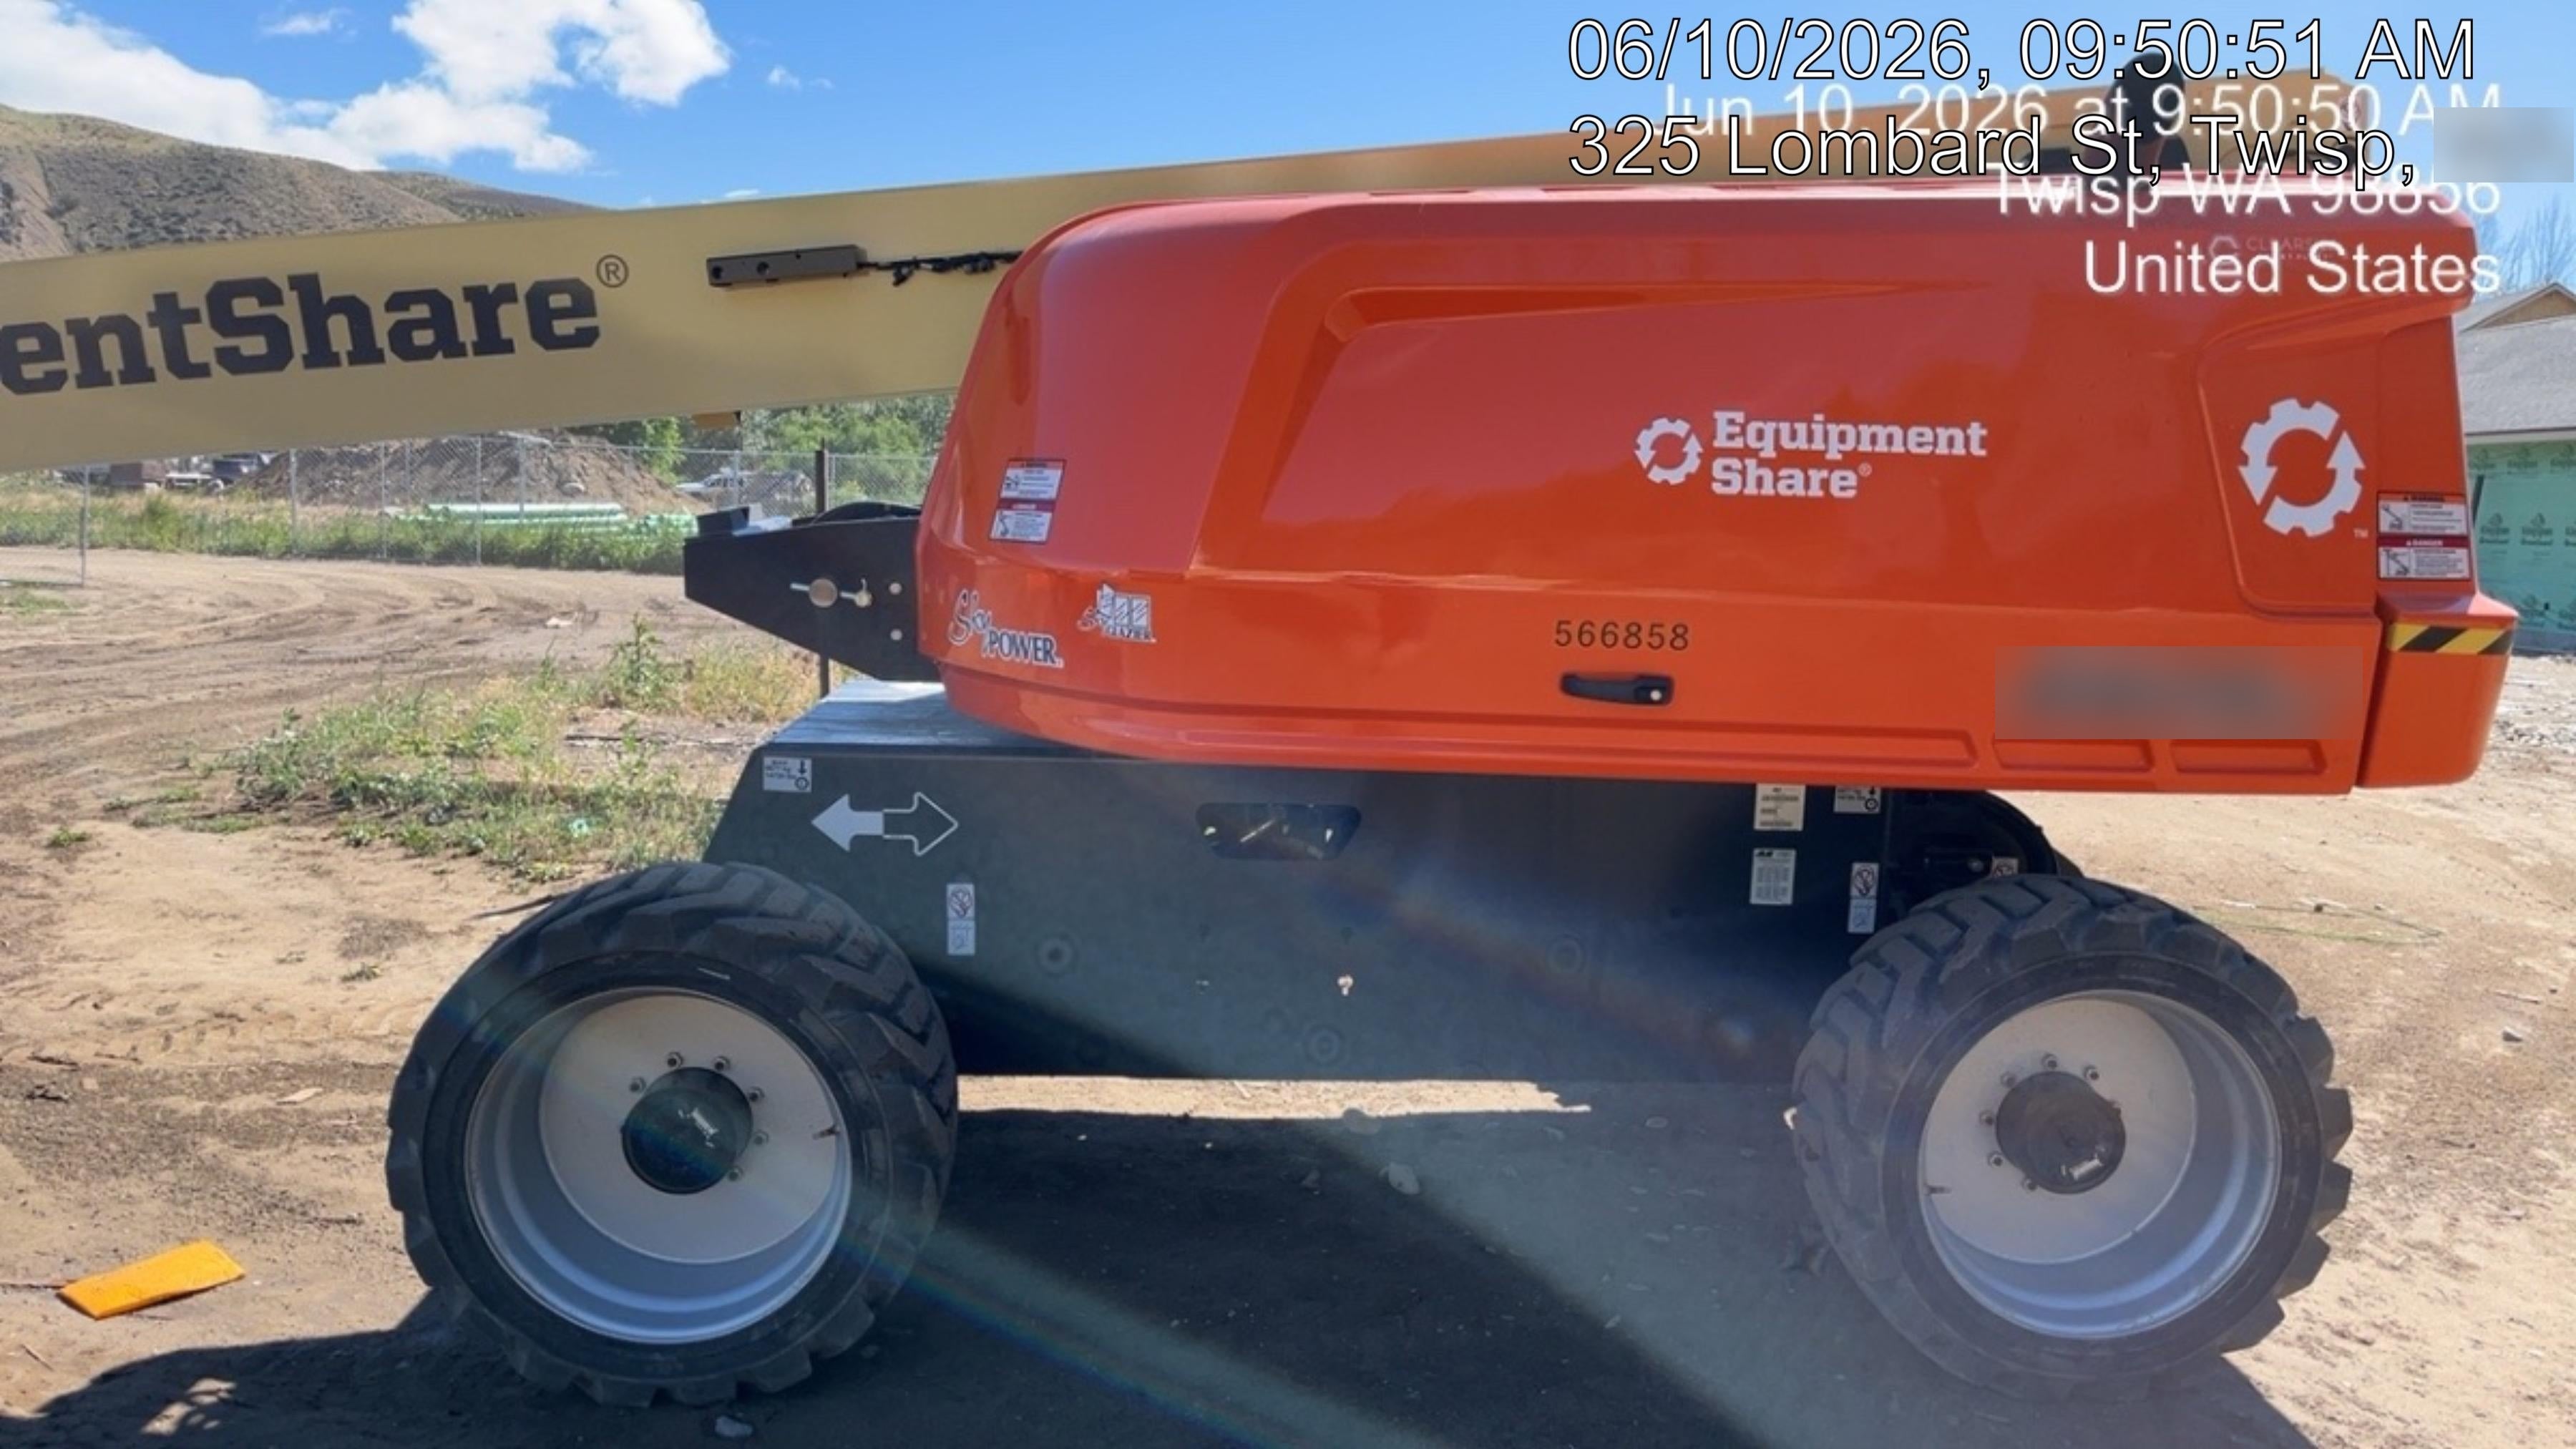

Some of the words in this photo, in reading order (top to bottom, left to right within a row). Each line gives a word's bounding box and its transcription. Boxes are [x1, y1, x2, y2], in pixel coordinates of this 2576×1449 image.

[1712, 411, 1988, 460] Equipment
[1711, 457, 1859, 499] Share
[987, 628, 1058, 665] POWER
[1554, 620, 1689, 651] 566858
